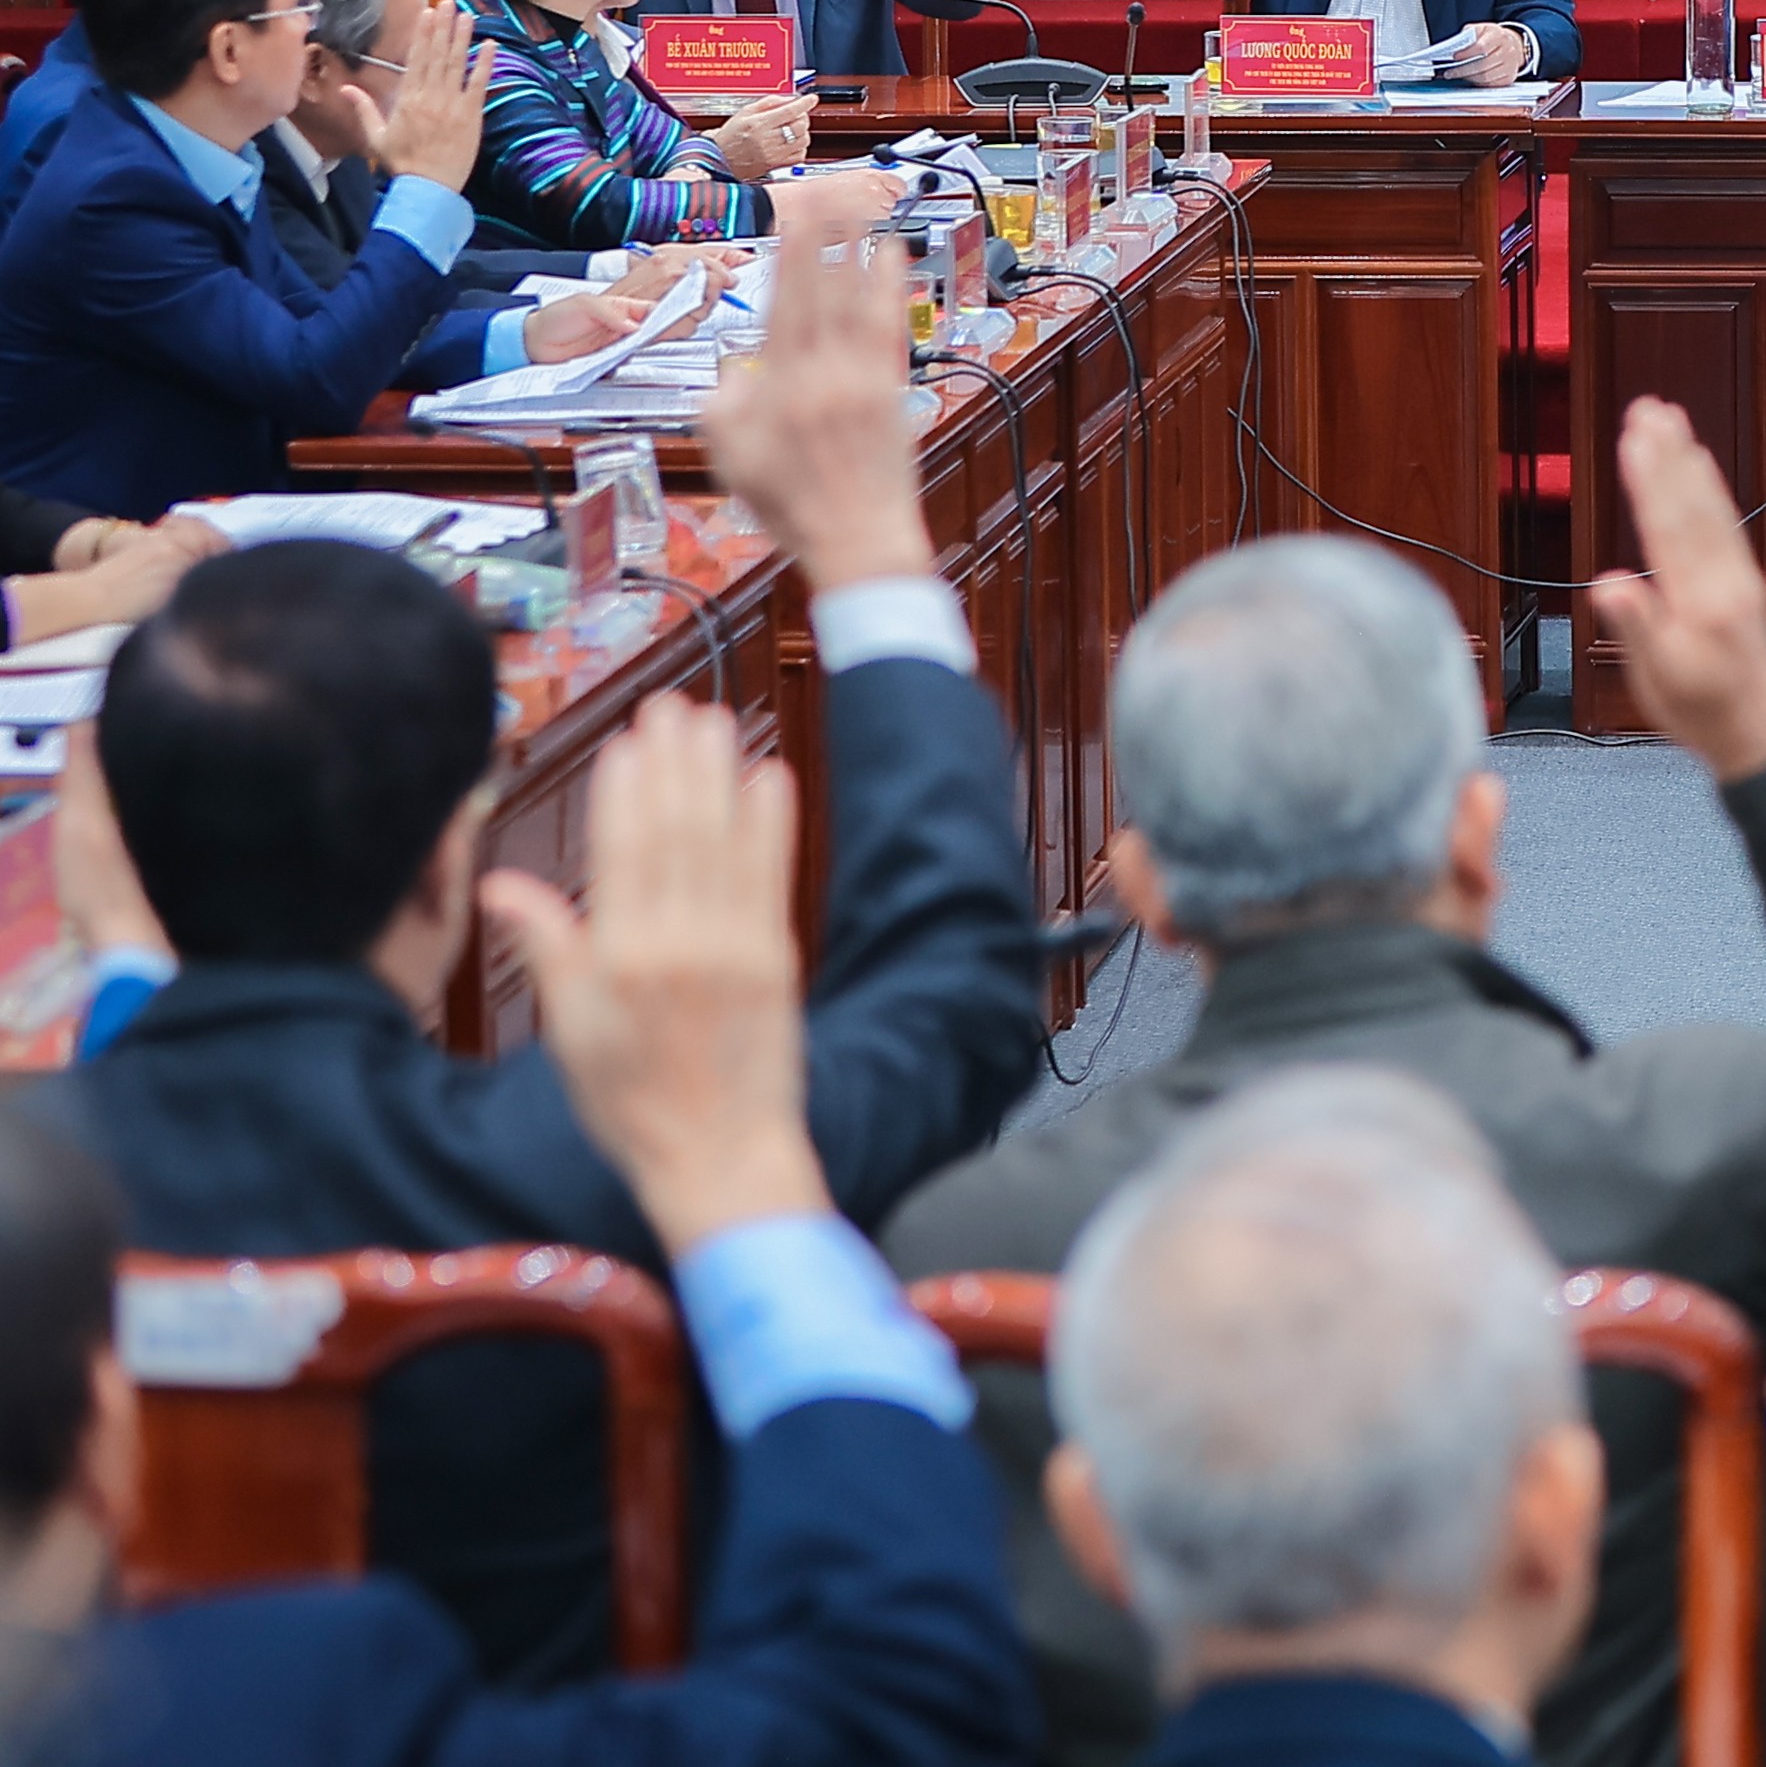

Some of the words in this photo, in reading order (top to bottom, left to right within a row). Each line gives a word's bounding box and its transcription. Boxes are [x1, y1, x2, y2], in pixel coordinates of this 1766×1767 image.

[667, 34, 682, 58] BẾ
[683, 37, 716, 58] XUÂN
[718, 37, 767, 58] TRƯỜNG
[1241, 41, 1281, 59] LƯƠNG
[1283, 35, 1316, 61] QUỐC
[1319, 39, 1352, 60] ĐOÀN
